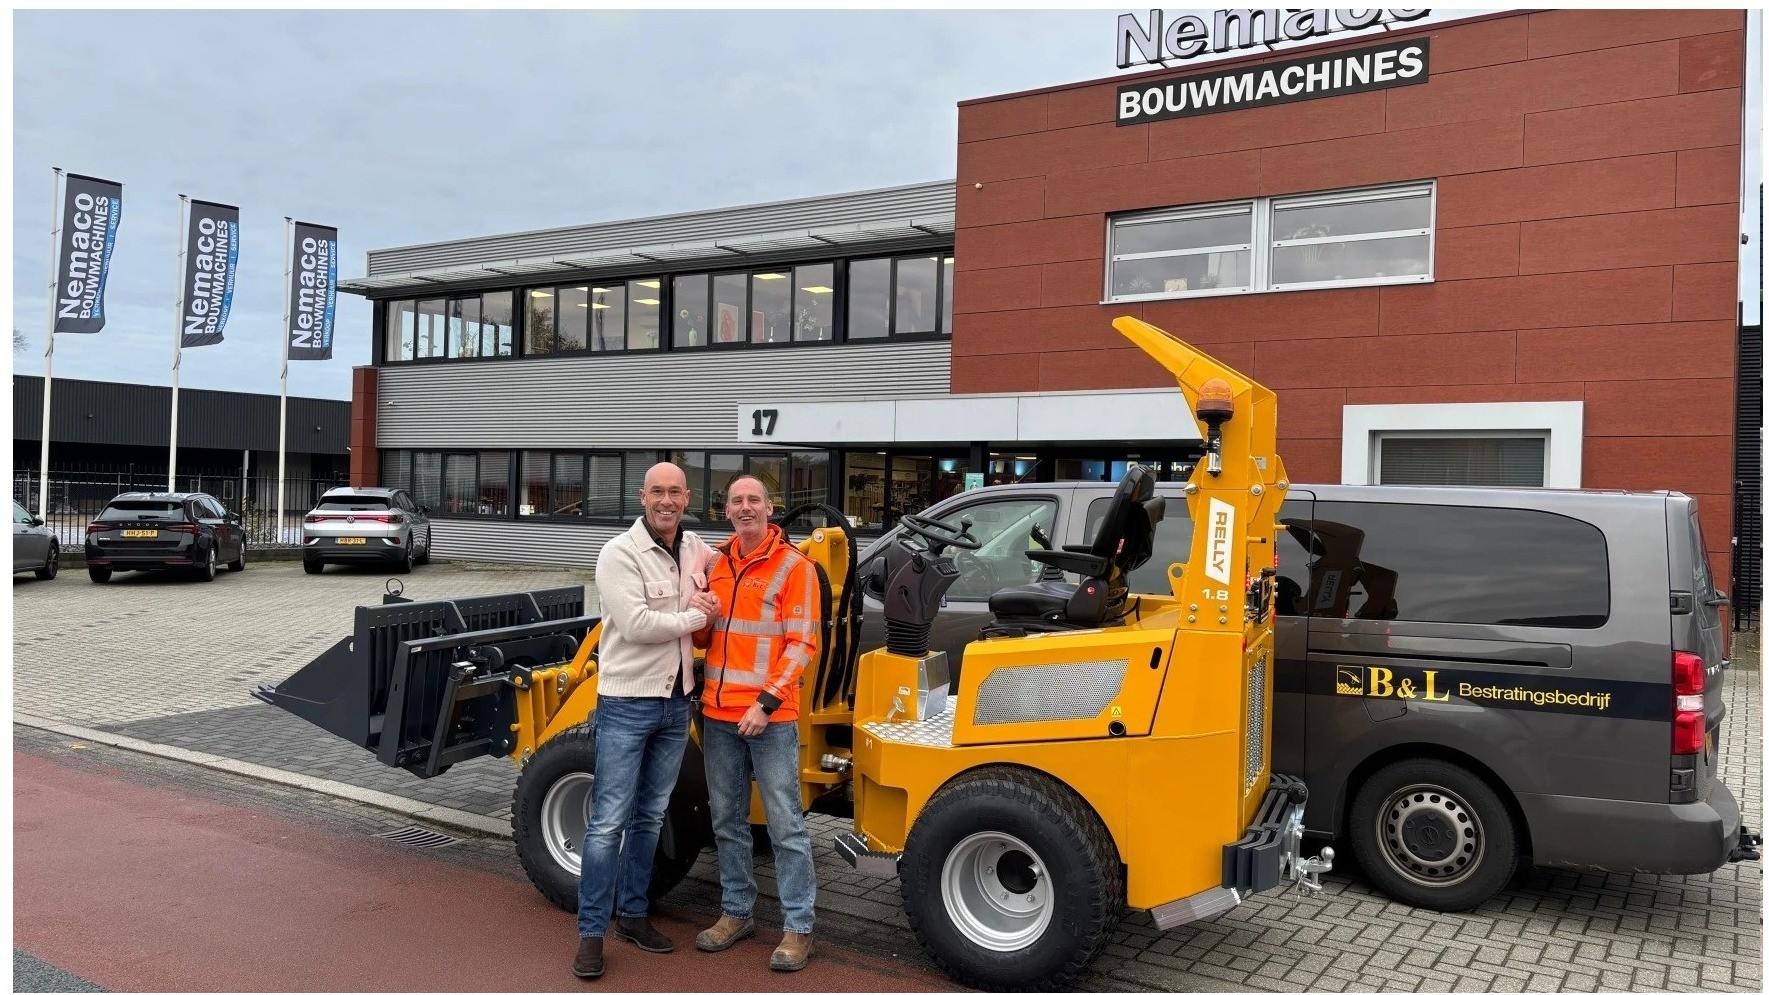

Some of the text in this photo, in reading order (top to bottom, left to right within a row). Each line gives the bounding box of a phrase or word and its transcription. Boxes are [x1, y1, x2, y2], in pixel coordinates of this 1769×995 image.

[1119, 46, 1424, 120] BOUWMACHINES
[59, 192, 94, 319] Nemaco
[79, 196, 109, 319] BOUWMACHINES
[110, 199, 119, 230] SERVICE
[185, 217, 216, 334] Nemaco
[205, 220, 228, 334] BOUWMACHINES
[292, 237, 317, 348] Nemaco
[313, 239, 328, 348] BOUWMACHINES
[752, 409, 778, 435] 17
[1211, 511, 1228, 573] RELLY
[1202, 588, 1229, 600] 1.8
[1459, 682, 1611, 710] Bestratingsbedrijf
